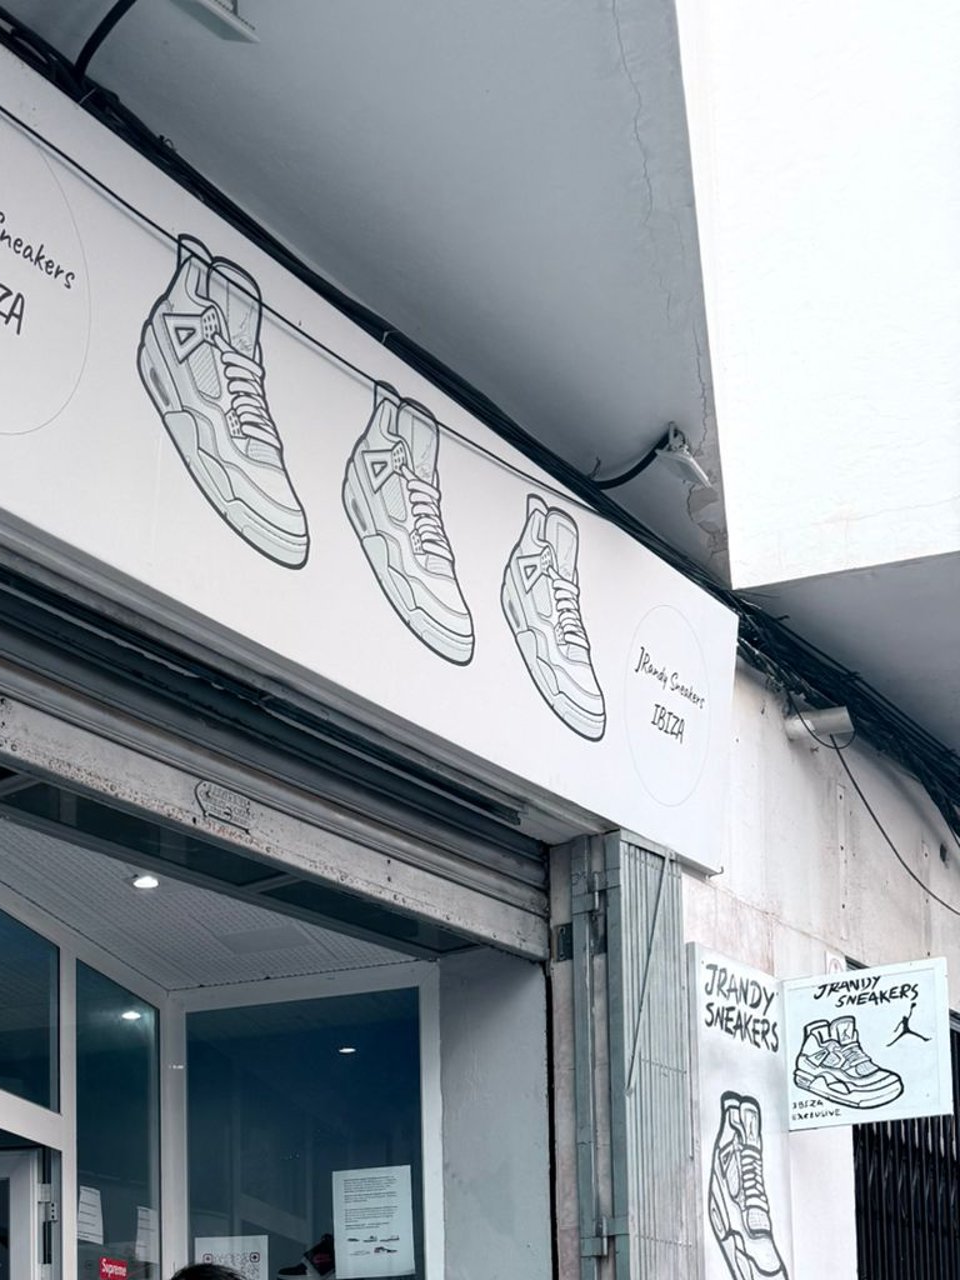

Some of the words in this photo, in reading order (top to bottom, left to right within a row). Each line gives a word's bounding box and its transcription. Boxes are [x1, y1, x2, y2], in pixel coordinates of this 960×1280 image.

[634, 646, 668, 691] JRandy
[670, 672, 706, 710] Sneakers
[651, 703, 686, 745] IBIZA
[704, 963, 776, 1017] JRANDY
[813, 975, 881, 1000] JRANDY
[835, 983, 919, 1008] SNEAKERS
[704, 1002, 780, 1052] SNEAKERS
